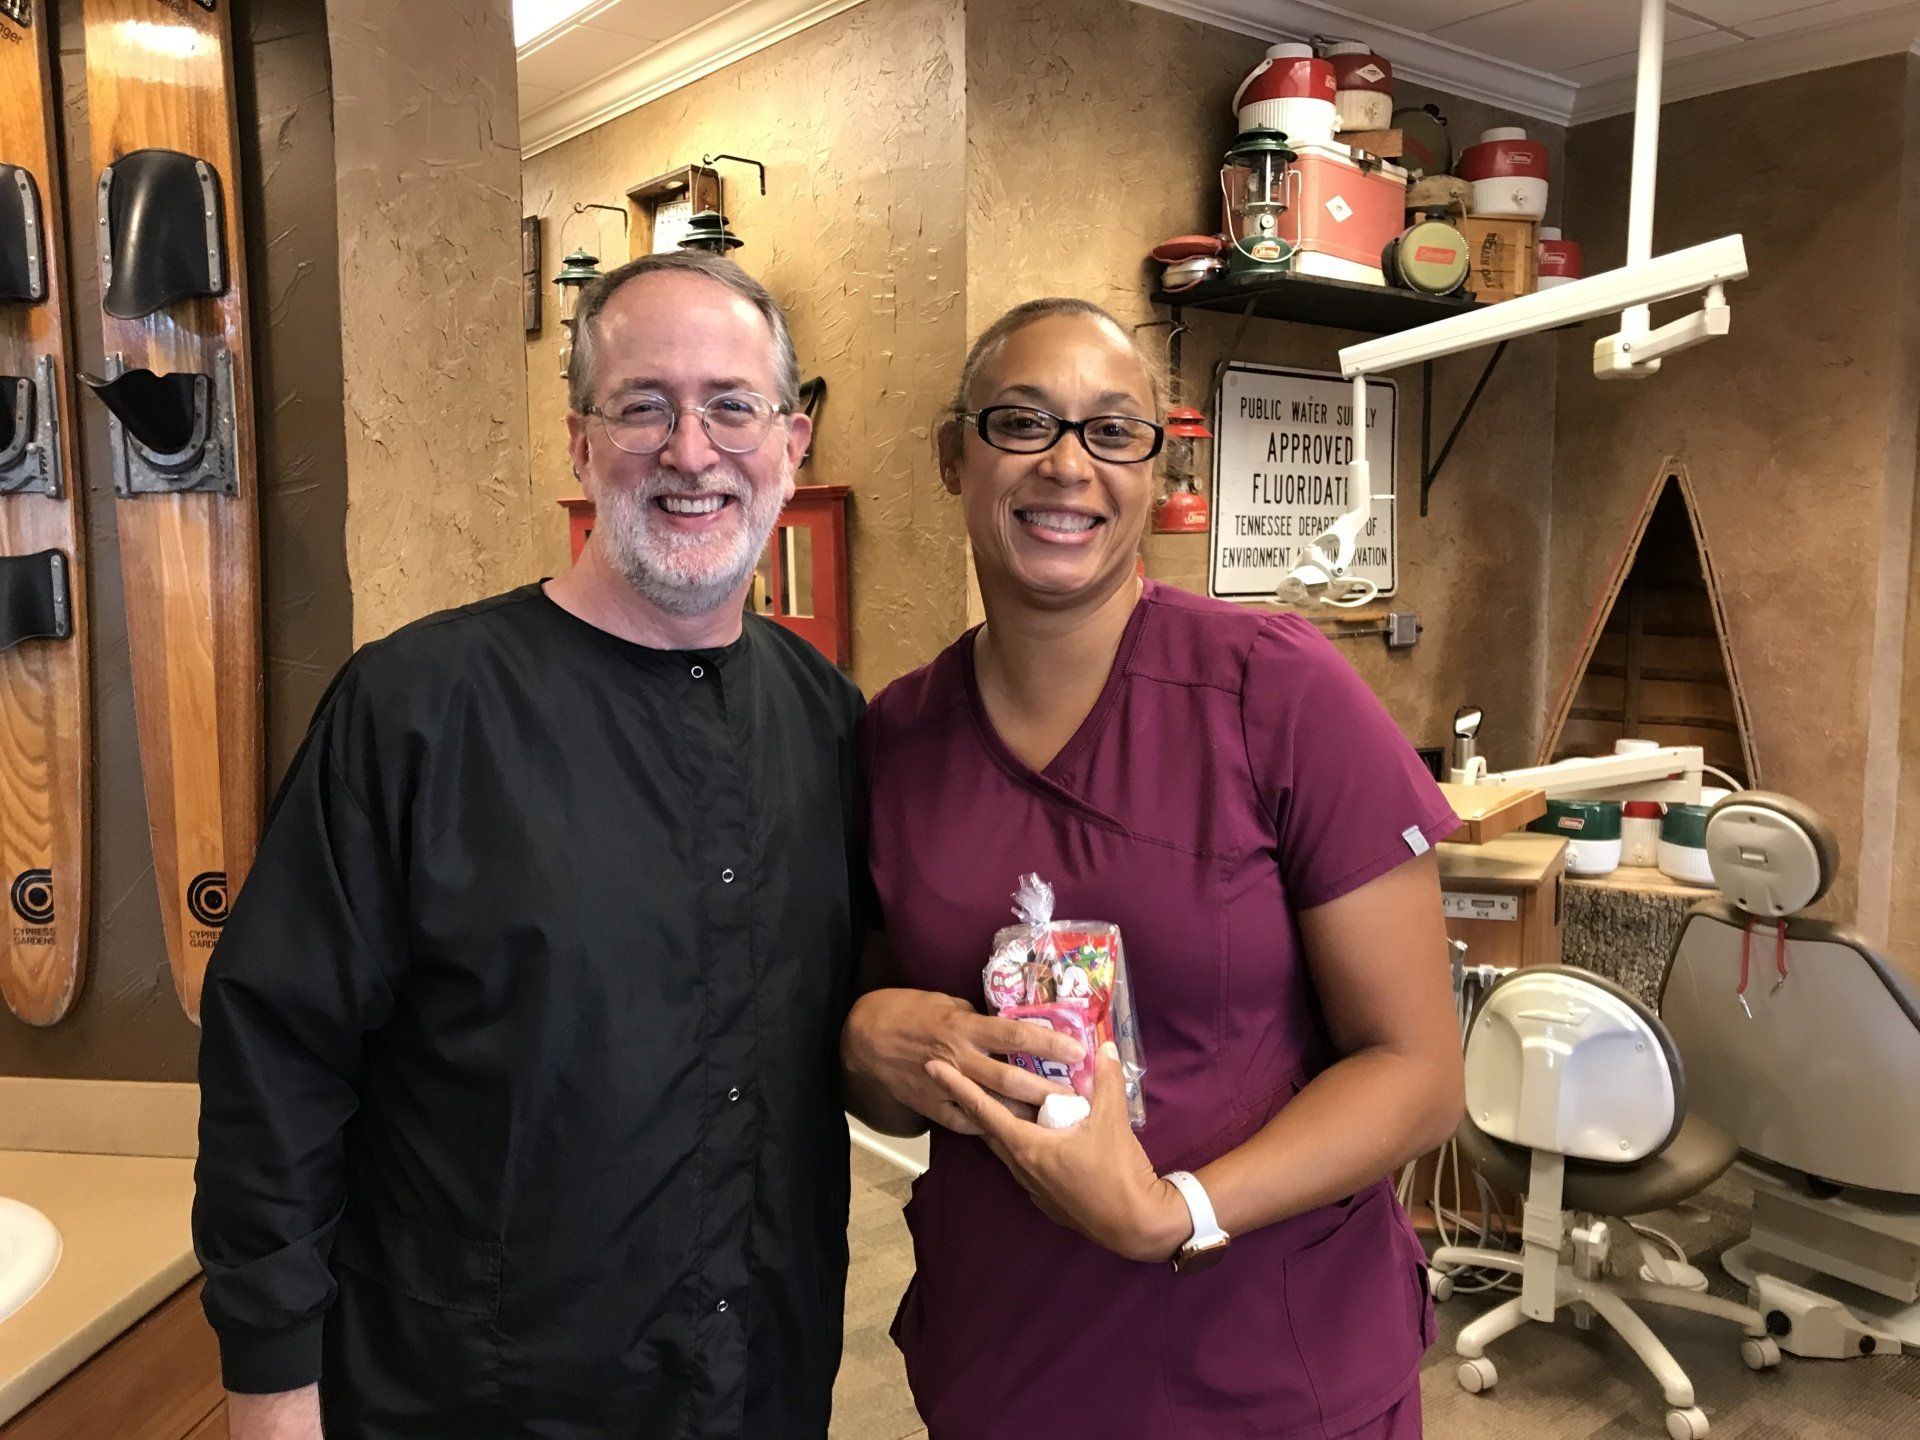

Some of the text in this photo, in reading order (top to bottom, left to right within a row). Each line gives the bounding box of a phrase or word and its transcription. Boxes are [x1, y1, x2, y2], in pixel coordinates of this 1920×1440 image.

[1240, 396, 1377, 429] PUBLIC WATER SULY
[1267, 431, 1354, 466] APPROVED
[1252, 472, 1349, 506] FLUORIDATI
[1235, 514, 1292, 537] TENNESSEE
[1365, 516, 1378, 537] OF
[1222, 547, 1291, 568] ENVIRONMENT
[13, 927, 56, 937] CYPRESS
[189, 930, 222, 940] CYPRE
